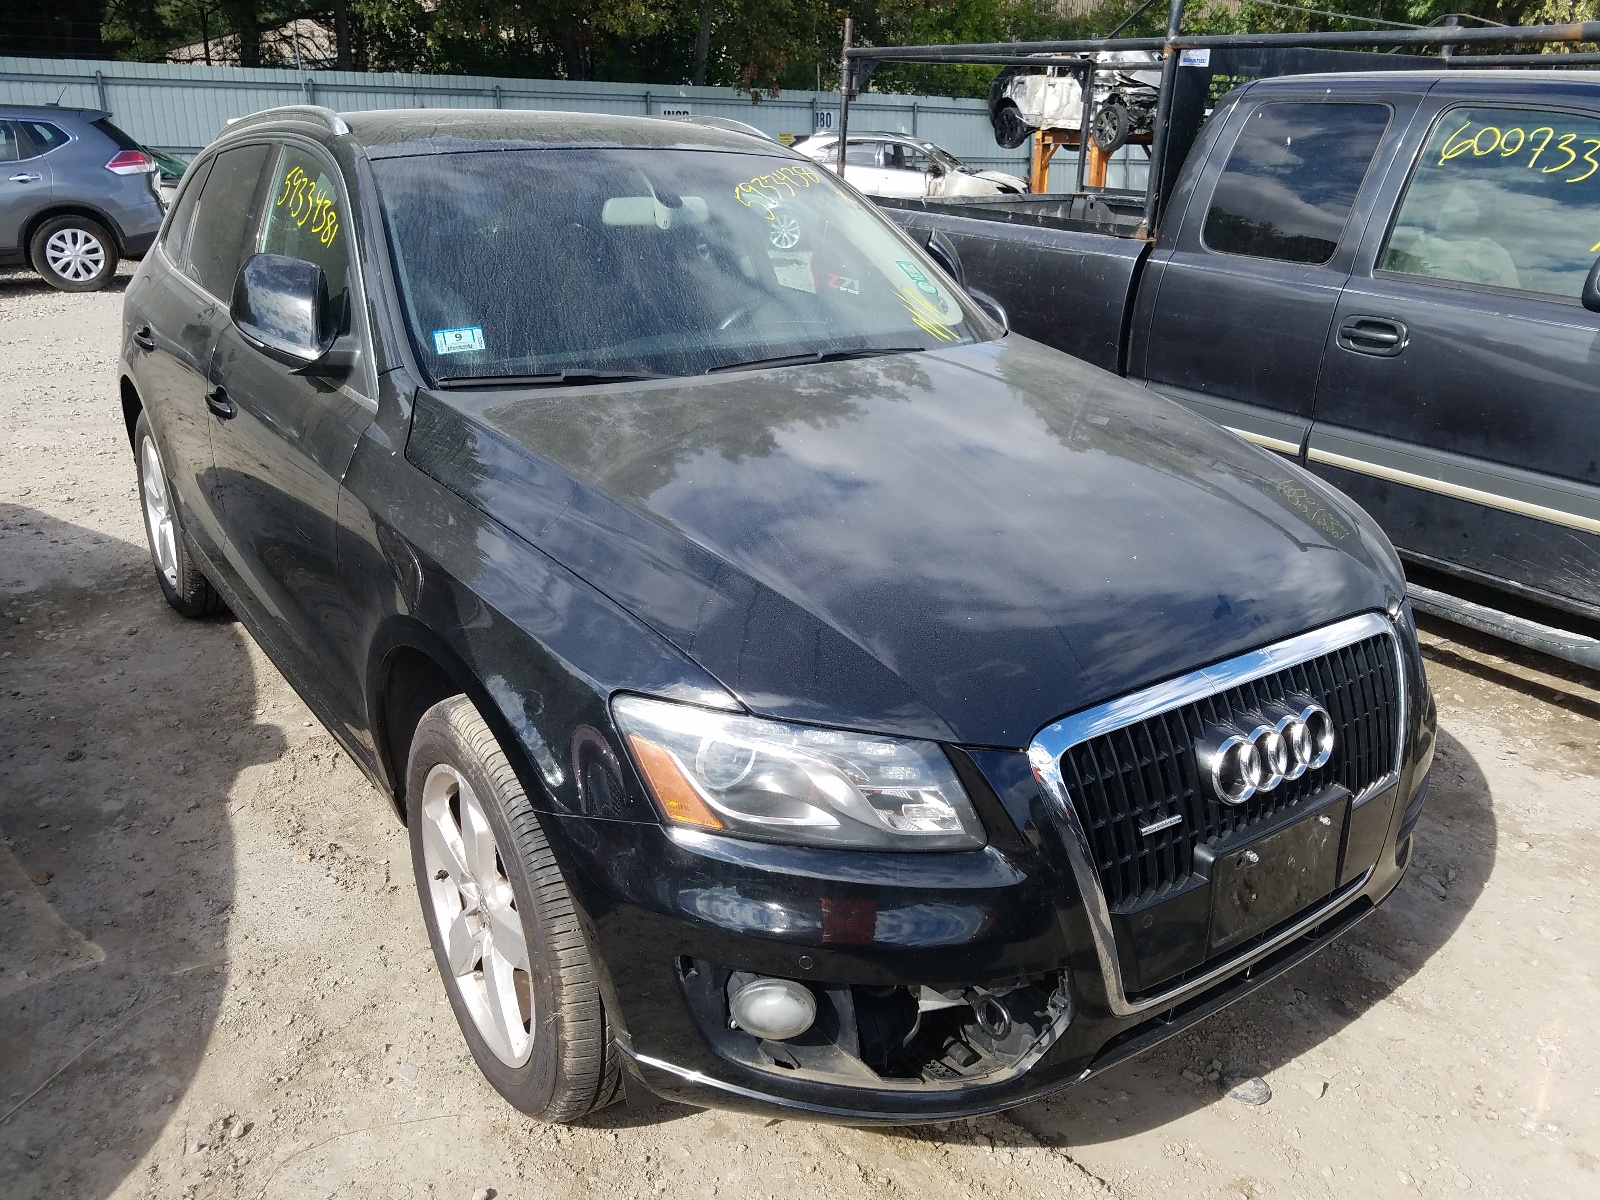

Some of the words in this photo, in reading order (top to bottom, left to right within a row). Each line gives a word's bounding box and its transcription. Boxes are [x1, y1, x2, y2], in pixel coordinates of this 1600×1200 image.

[815, 112, 832, 128] 180
[277, 166, 339, 248] 59334381
[826, 272, 860, 291] Z71
[454, 333, 463, 342] 9
